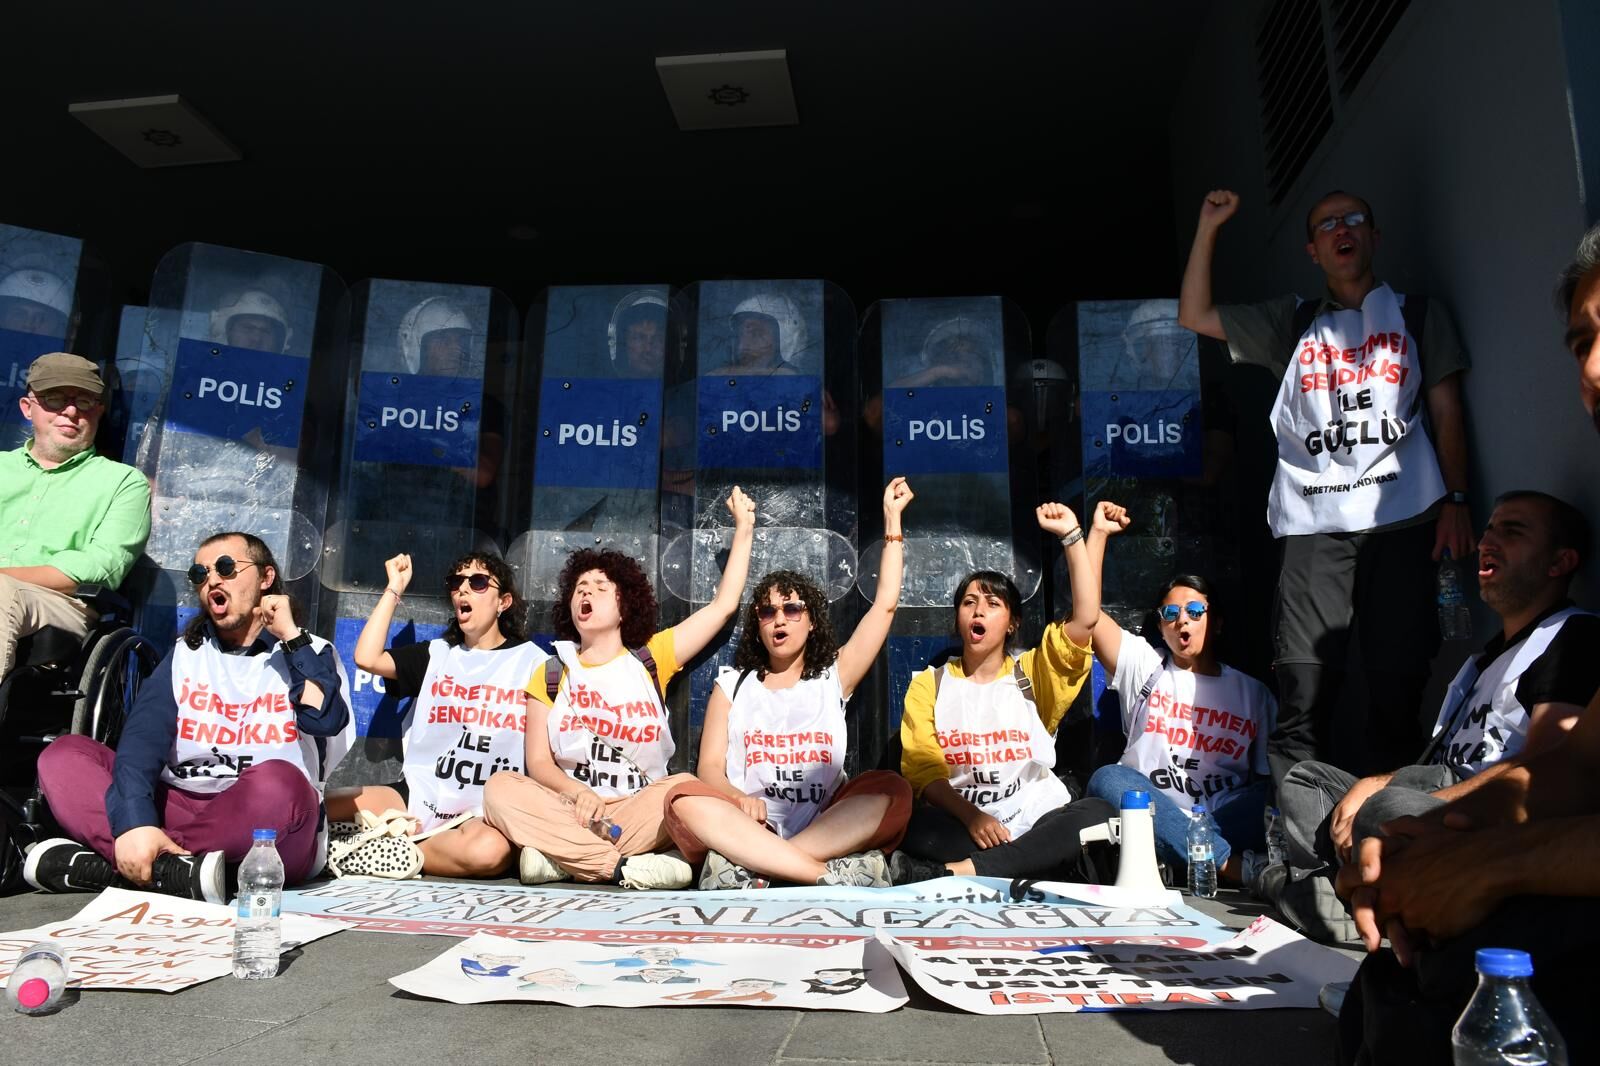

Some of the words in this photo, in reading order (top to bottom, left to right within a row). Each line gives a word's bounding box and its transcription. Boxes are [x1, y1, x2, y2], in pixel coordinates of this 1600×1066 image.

[199, 377, 283, 409] POLİS
[1337, 388, 1373, 414] İLE
[381, 406, 460, 432] POLİS
[722, 406, 801, 432] POLİS
[909, 414, 986, 440] POLİS
[558, 419, 638, 447] POLİS
[1106, 419, 1182, 444] POLİS
[1302, 483, 1351, 496] ÖĞRETMEN
[179, 677, 295, 722] ĞRETME
[175, 717, 302, 746] ENDİKAS
[457, 724, 491, 753] İLE
[743, 729, 833, 748] ÖĞRETMEN
[936, 728, 1030, 749] ÖĞRETMEN
[590, 736, 624, 763] İLE
[746, 748, 833, 768] SENDİKASI
[775, 766, 804, 782] İLE
[972, 767, 1001, 785] İLE
[954, 777, 1021, 807] ÜÇLÜ!
[324, 900, 564, 924] OLANI
[347, 919, 407, 930] ZEL
[421, 925, 587, 939] SEKTÖR
[922, 944, 1259, 966] ATRONLARIN
[924, 972, 1110, 990] YUSUF
[1122, 972, 1294, 988] TEKİN
[974, 964, 1194, 977] BAKANI
[988, 990, 1241, 1006] İSTİFA!
